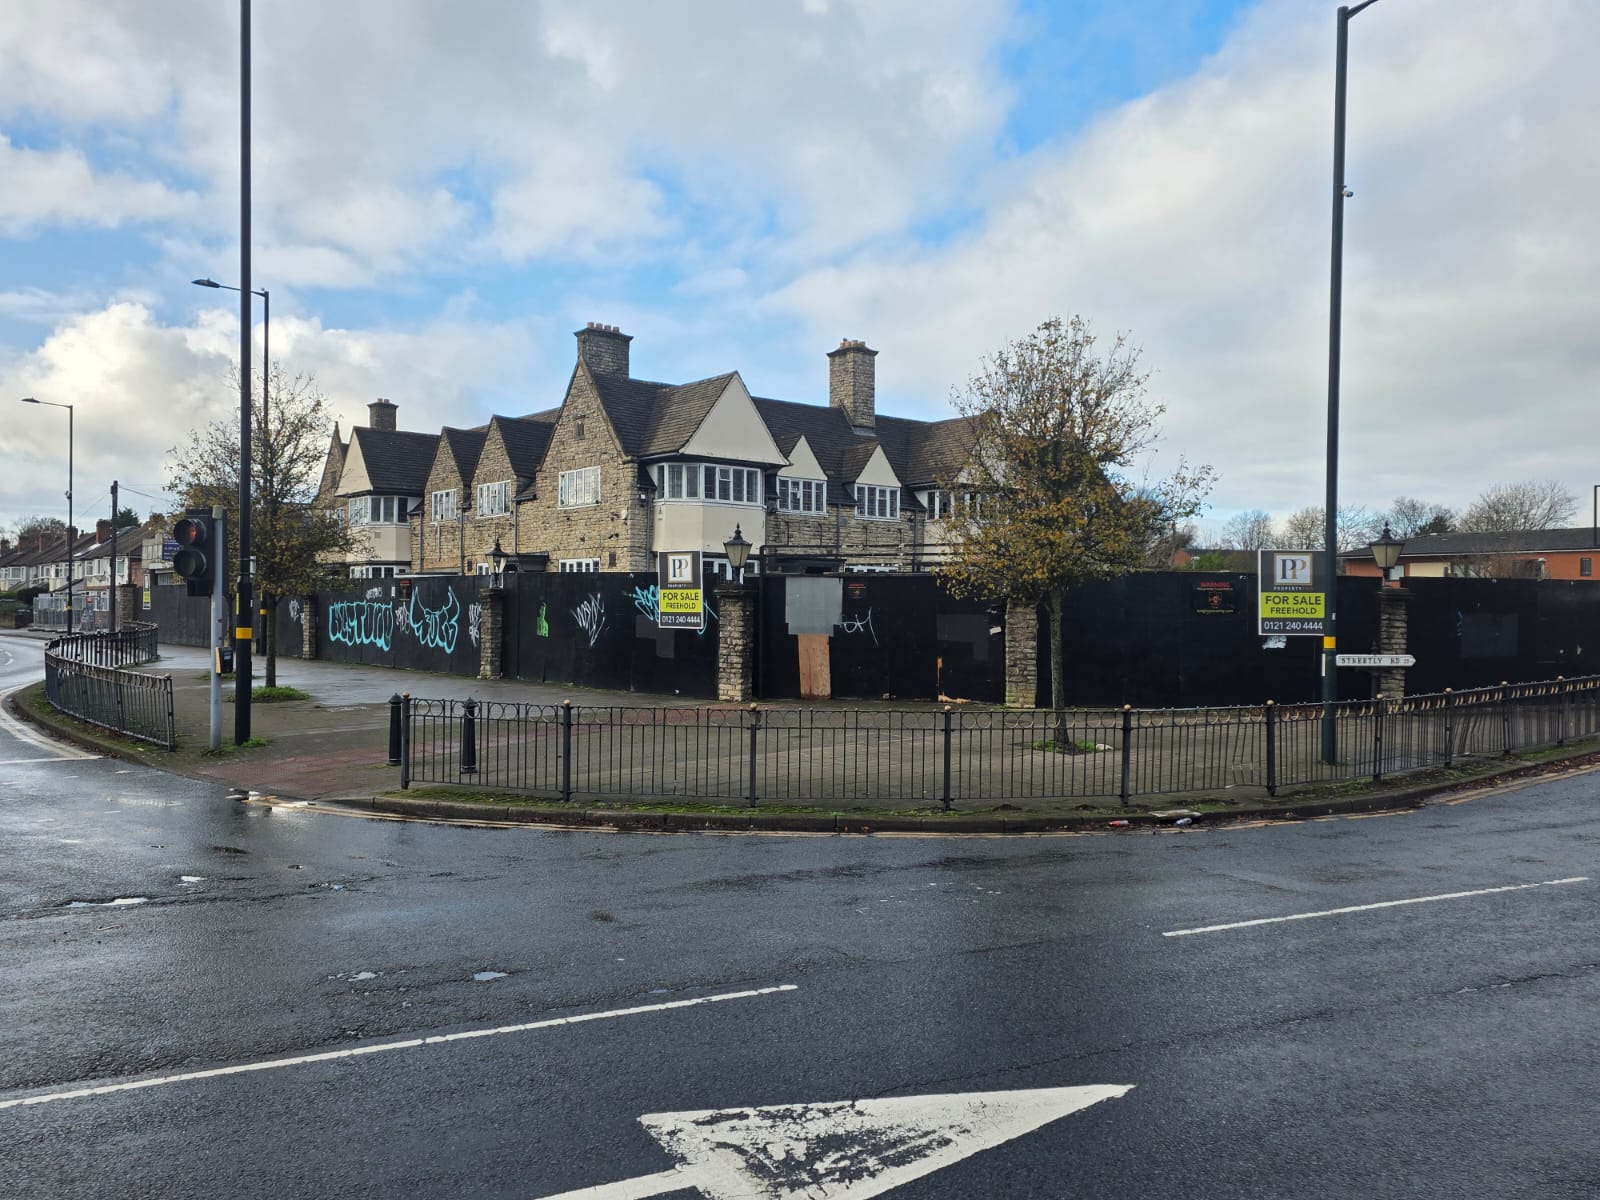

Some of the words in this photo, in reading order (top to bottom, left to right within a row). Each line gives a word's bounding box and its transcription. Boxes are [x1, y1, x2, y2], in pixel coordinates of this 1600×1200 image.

[662, 592, 678, 601] FOR
[680, 592, 699, 601] SALE
[1265, 595, 1289, 605] FOR
[1293, 595, 1322, 606] SALE
[666, 602, 696, 610] FREEHOLD
[1270, 606, 1317, 615] FREEHOLD
[661, 615, 675, 624] 0121
[675, 615, 686, 624] 240
[686, 615, 700, 624] 4444
[1264, 621, 1284, 630] 0121
[1286, 621, 1302, 630] 240
[1303, 621, 1323, 630] 4444
[1390, 657, 1401, 665] RD
